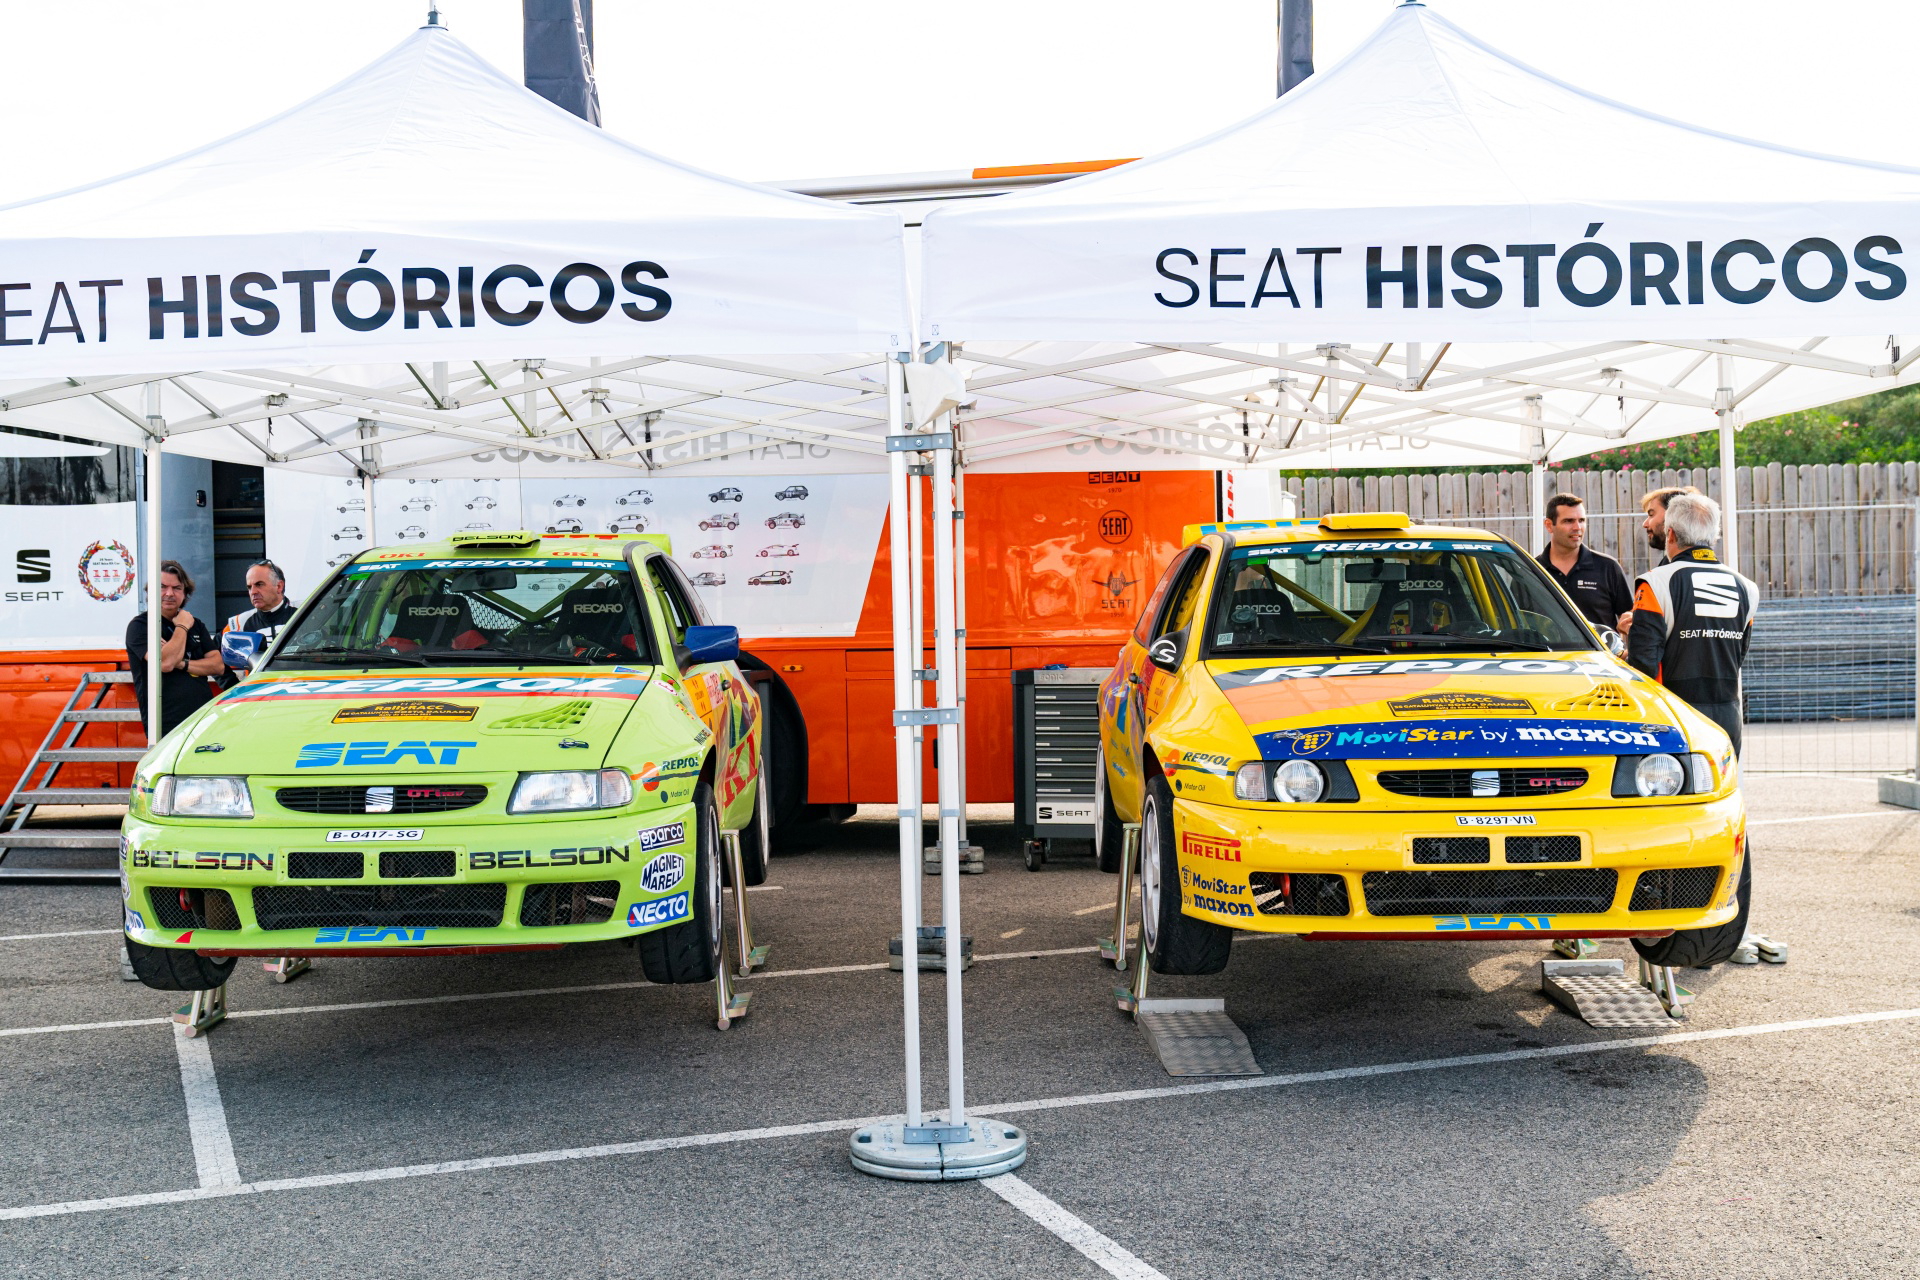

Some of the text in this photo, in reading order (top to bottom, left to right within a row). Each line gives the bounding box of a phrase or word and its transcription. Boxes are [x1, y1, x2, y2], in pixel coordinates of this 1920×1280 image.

[1154, 221, 1907, 310] SEAT HISTÓRICOS
[0, 248, 672, 346] EAT HISTÓRICOS
[1088, 471, 1141, 484] SEAT
[1102, 517, 1128, 536] SEAT
[452, 534, 523, 543] BELSON
[1248, 547, 1292, 556] SEAT
[1312, 541, 1435, 552] REPSOL
[1451, 543, 1494, 551] SEAT
[379, 552, 426, 560] OKI
[357, 563, 402, 572] SEAT
[423, 560, 550, 568] REPSOL
[571, 561, 616, 569] SEAT
[1398, 578, 1444, 592] sparco
[5, 591, 64, 602] SEAT
[408, 605, 460, 617] RECARO
[573, 602, 624, 614] RECARO
[1101, 599, 1132, 609] SEAT
[1679, 628, 1744, 640] SEAT HISTÓRICOS
[1249, 658, 1635, 684] REPSOL
[246, 677, 623, 696] REPSOL
[1335, 727, 1661, 747] MoviStar by maxon
[295, 741, 477, 769] SEAT
[1182, 751, 1232, 767] REPSOL
[661, 757, 700, 772] REPSOL
[1184, 782, 1206, 792] Motor Oil
[670, 790, 683, 799] Motor
[641, 823, 683, 848] sparco
[1182, 830, 1242, 863] PIRELLI
[133, 849, 274, 871] BELSON
[469, 845, 630, 870] BELSON
[1192, 872, 1247, 895] MoviStar
[1183, 892, 1254, 917] by maxon
[1432, 913, 1557, 930] SEAT
[314, 926, 438, 944] SEAT
